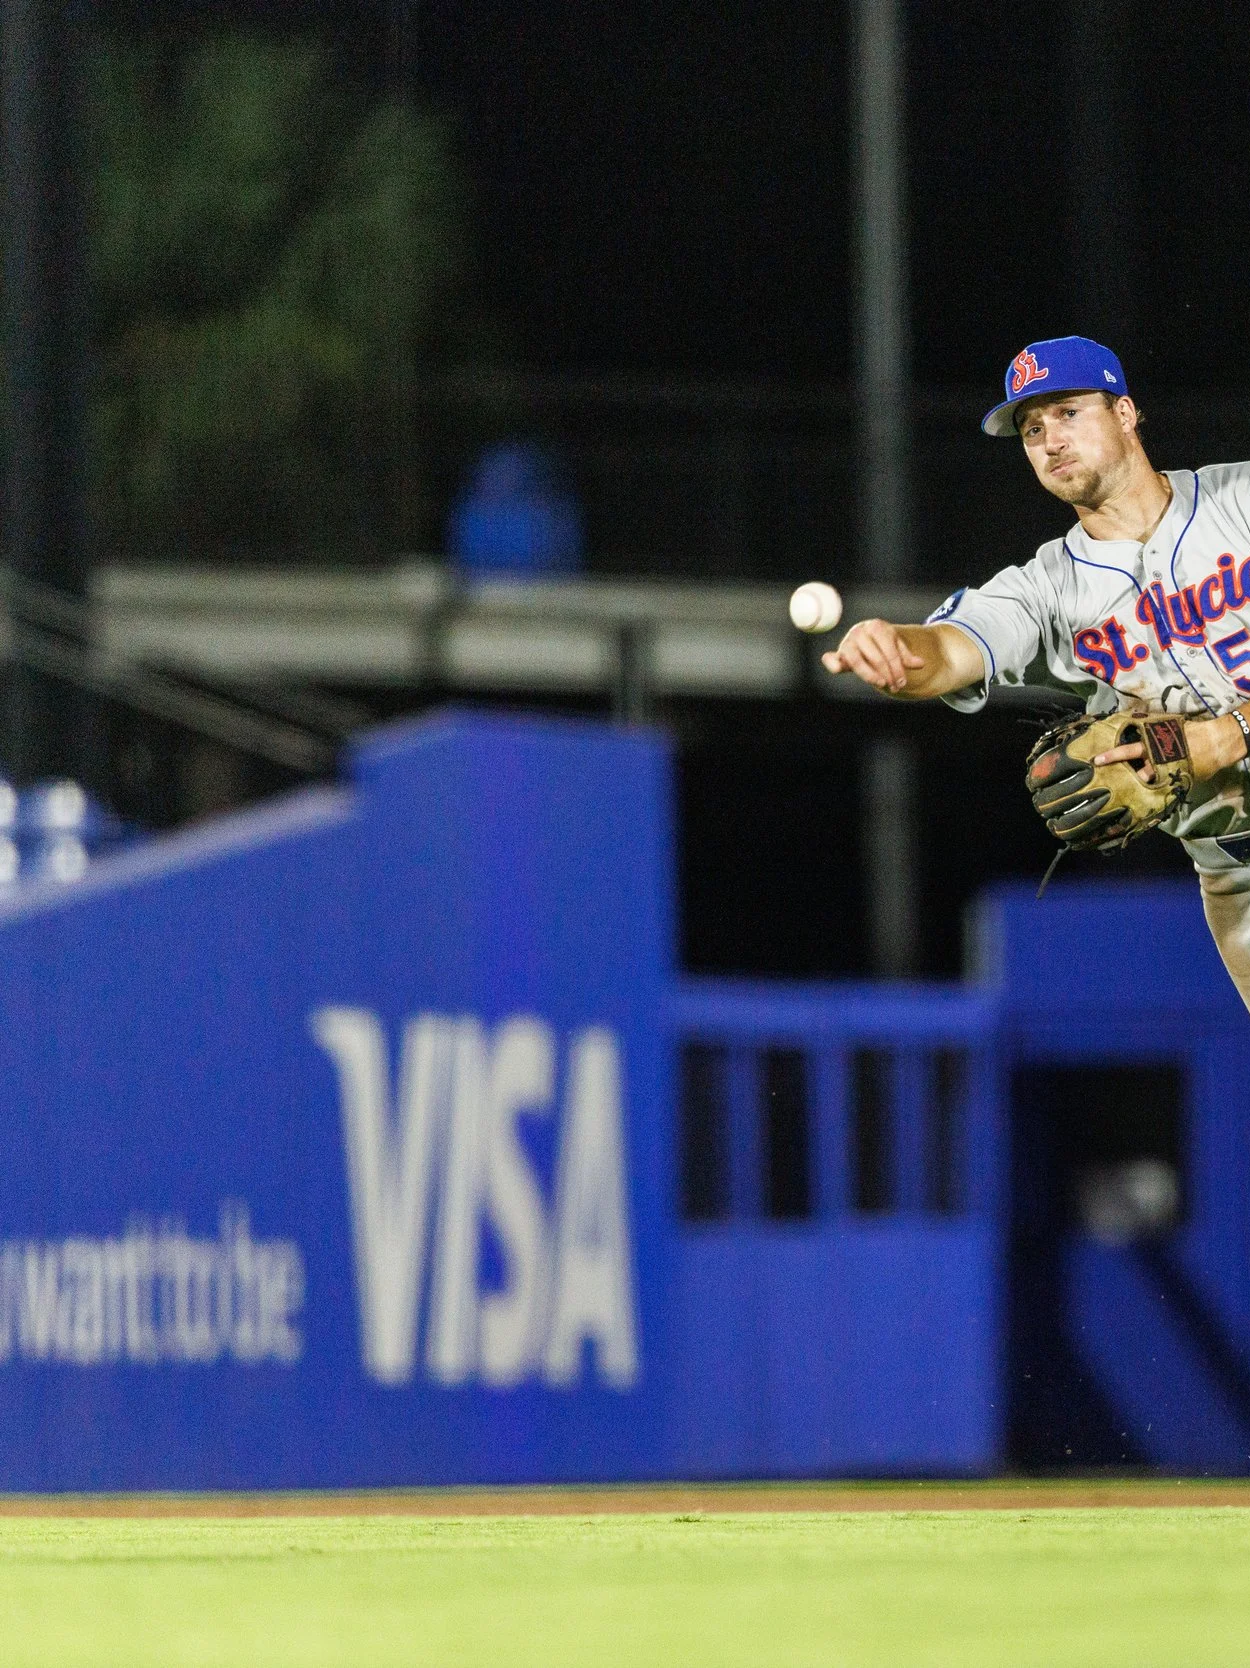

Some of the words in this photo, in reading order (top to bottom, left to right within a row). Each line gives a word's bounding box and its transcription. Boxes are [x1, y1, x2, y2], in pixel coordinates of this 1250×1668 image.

[1074, 615, 1150, 687] St.
[312, 1007, 638, 1388] VISA
[219, 1200, 304, 1358] be
